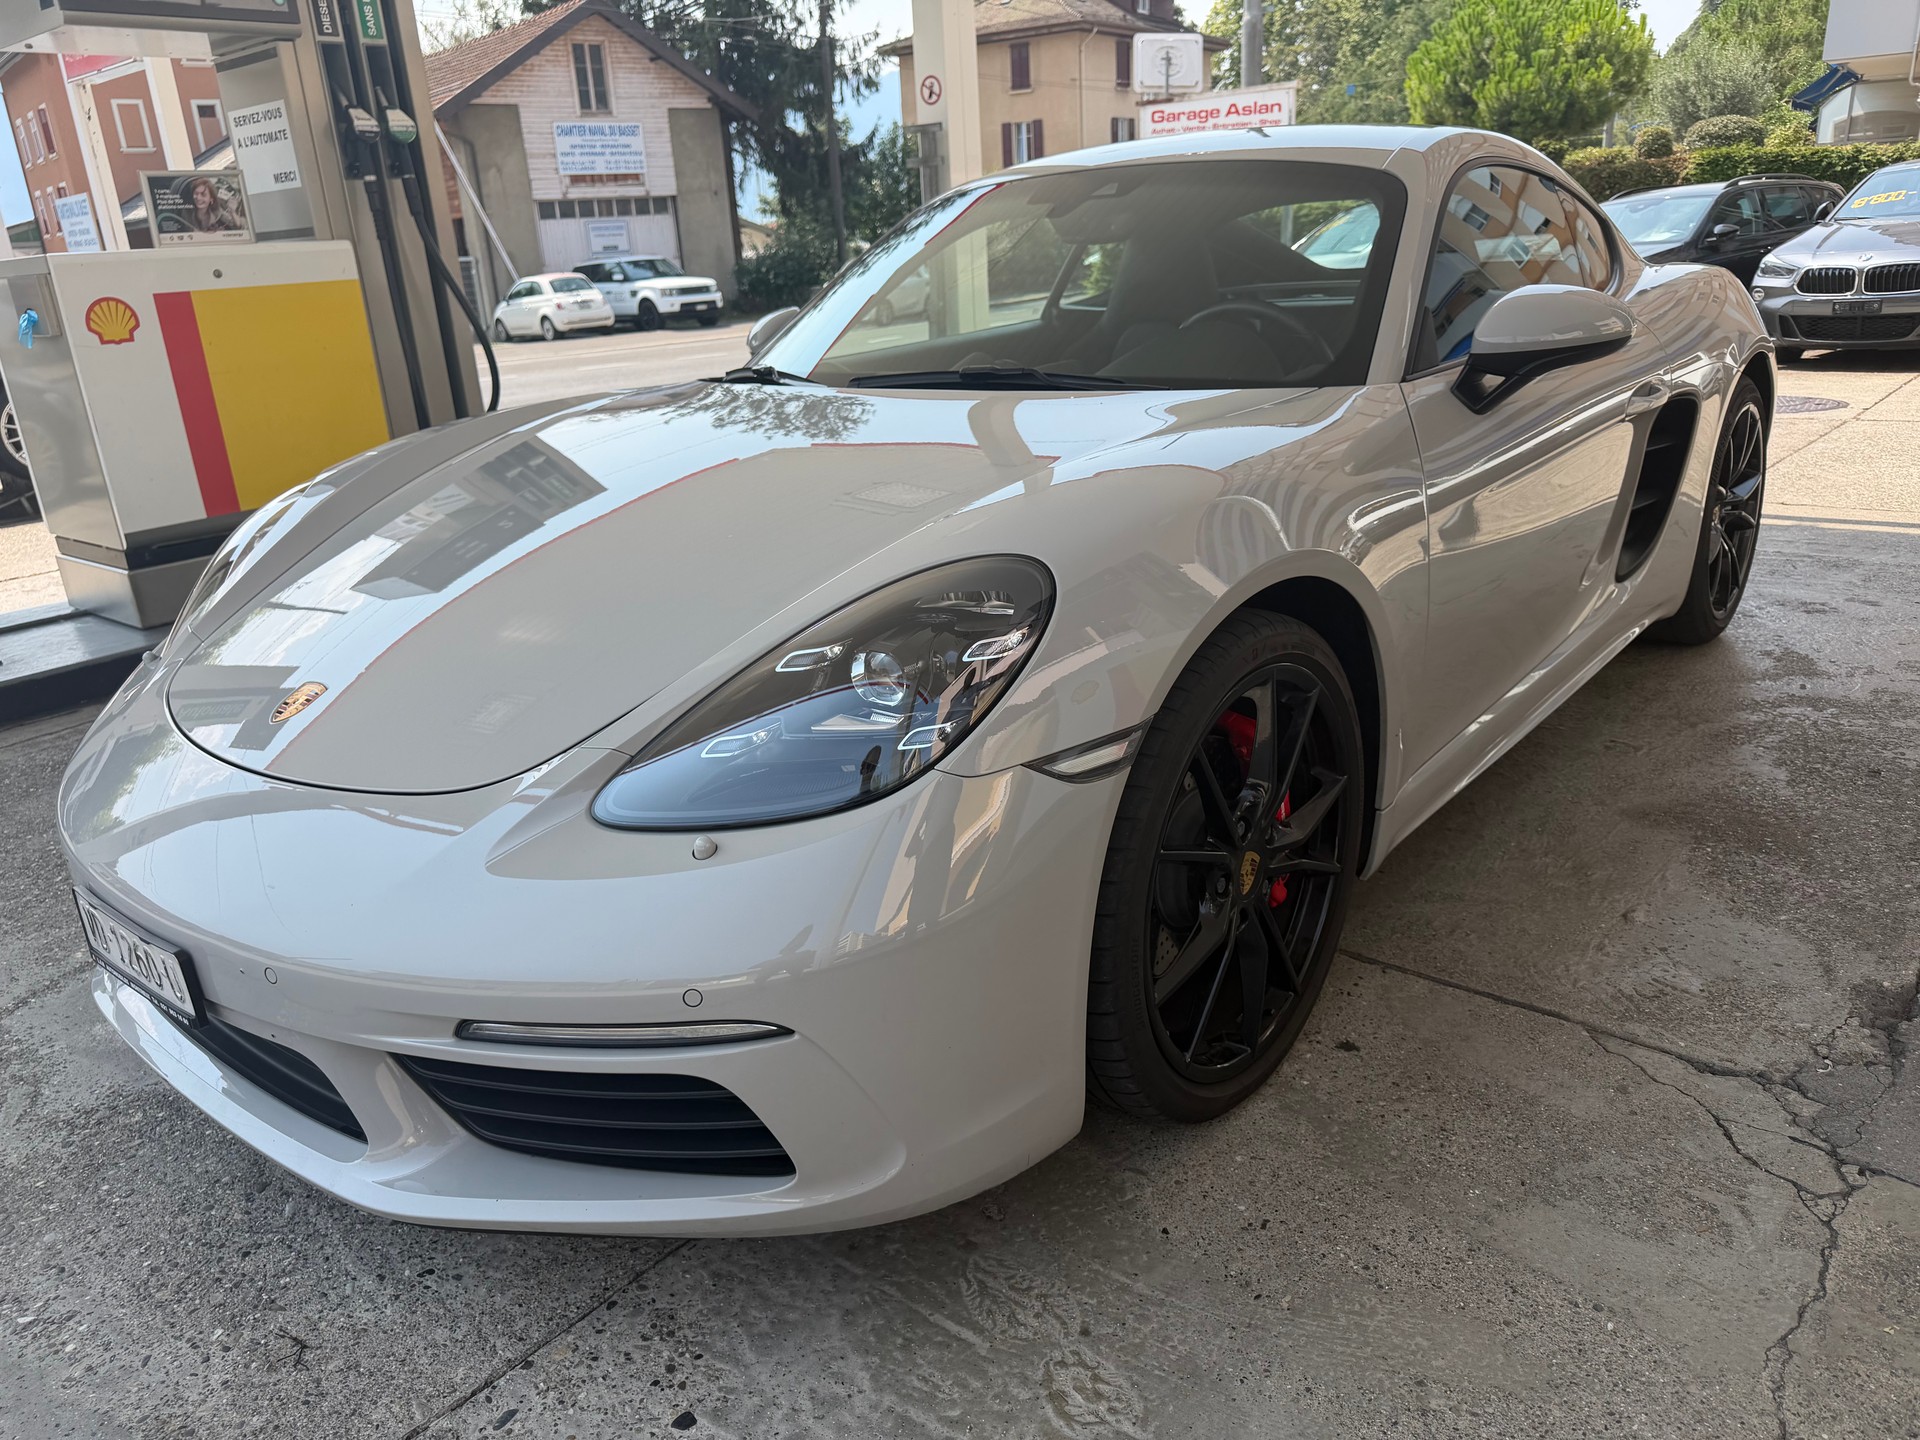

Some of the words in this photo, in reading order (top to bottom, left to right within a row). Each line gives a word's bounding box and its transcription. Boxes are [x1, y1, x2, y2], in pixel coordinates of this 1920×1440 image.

[363, 5, 377, 36] SANS
[233, 107, 283, 128] SERVEZ-VOUS
[1151, 108, 1220, 123] Garage
[1225, 101, 1282, 117] Aslan
[238, 138, 244, 149] A
[243, 129, 289, 148] L'AUTOMATE
[556, 124, 587, 137] CHANTIER
[588, 124, 608, 137] NAVAL
[273, 170, 297, 184] MERCI
